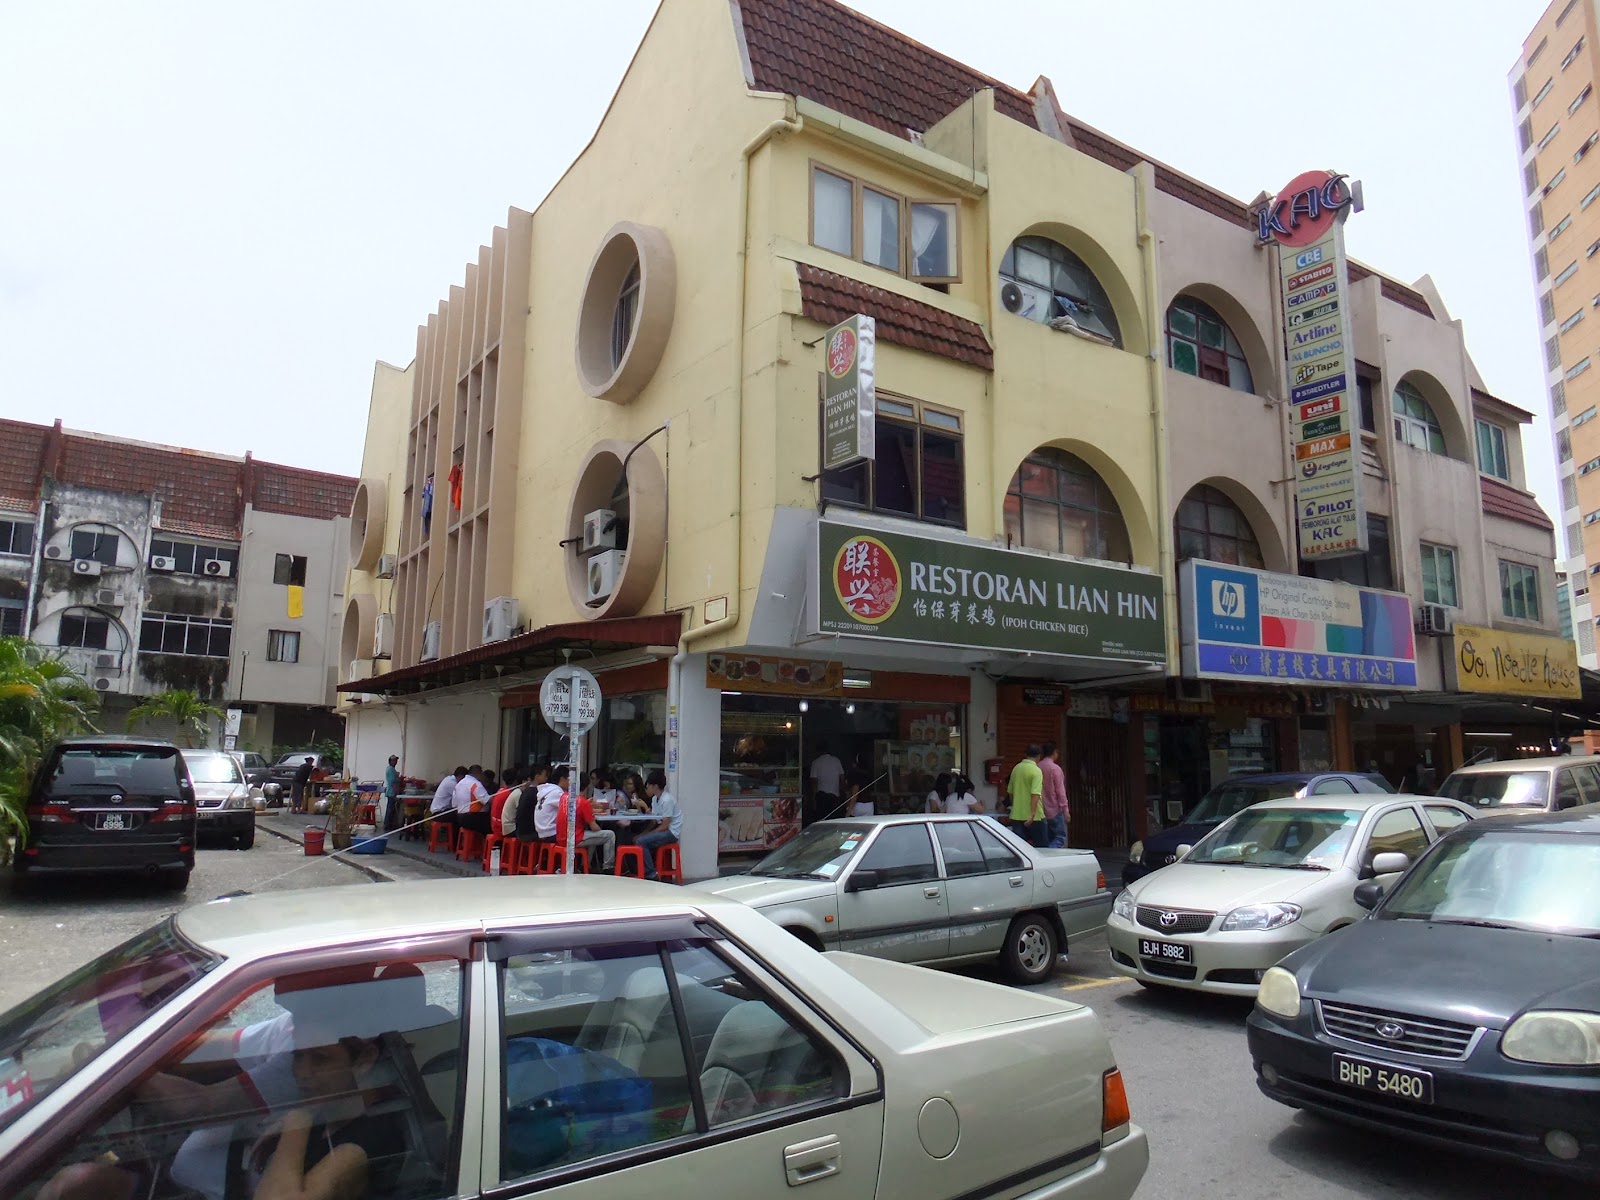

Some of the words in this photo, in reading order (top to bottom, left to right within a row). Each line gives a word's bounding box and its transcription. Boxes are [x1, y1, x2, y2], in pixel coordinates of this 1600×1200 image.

[1258, 174, 1353, 241] KAC
[1297, 248, 1321, 267] CBE
[1299, 266, 1332, 283] STABILO
[1293, 323, 1336, 345] Artline
[1304, 340, 1341, 359] BUNCHO
[1315, 360, 1339, 372] Tape
[826, 387, 857, 407] RESTORAN
[1301, 380, 1340, 397] STAEDTLER
[827, 404, 842, 417] LIAN
[843, 398, 856, 410] HIN
[1307, 399, 1333, 414] uni
[1310, 438, 1336, 454] MAX
[1317, 499, 1353, 514] PILOT
[1312, 525, 1344, 541] KAC
[910, 561, 1047, 607] RESTORAN
[1057, 582, 1109, 615] LIAN
[1117, 591, 1157, 621] HIN
[1260, 587, 1270, 598] HP
[1271, 588, 1300, 605] Original
[1302, 593, 1333, 609] Cartridge
[1334, 597, 1351, 610] Store
[913, 598, 996, 627] 怡保芽菜鸡
[822, 620, 837, 629] MPSJ
[1001, 614, 1027, 629] (IPOH
[1029, 619, 1066, 633] CHICKEN
[1068, 623, 1089, 637] RICE)
[1214, 621, 1245, 631] invent
[580, 699, 590, 708] 016
[107, 813, 122, 822] BHN
[1143, 941, 1160, 955] BJH
[1162, 944, 1185, 959] 5882
[1340, 1060, 1372, 1086] BHP
[1377, 1070, 1423, 1099] 5480
